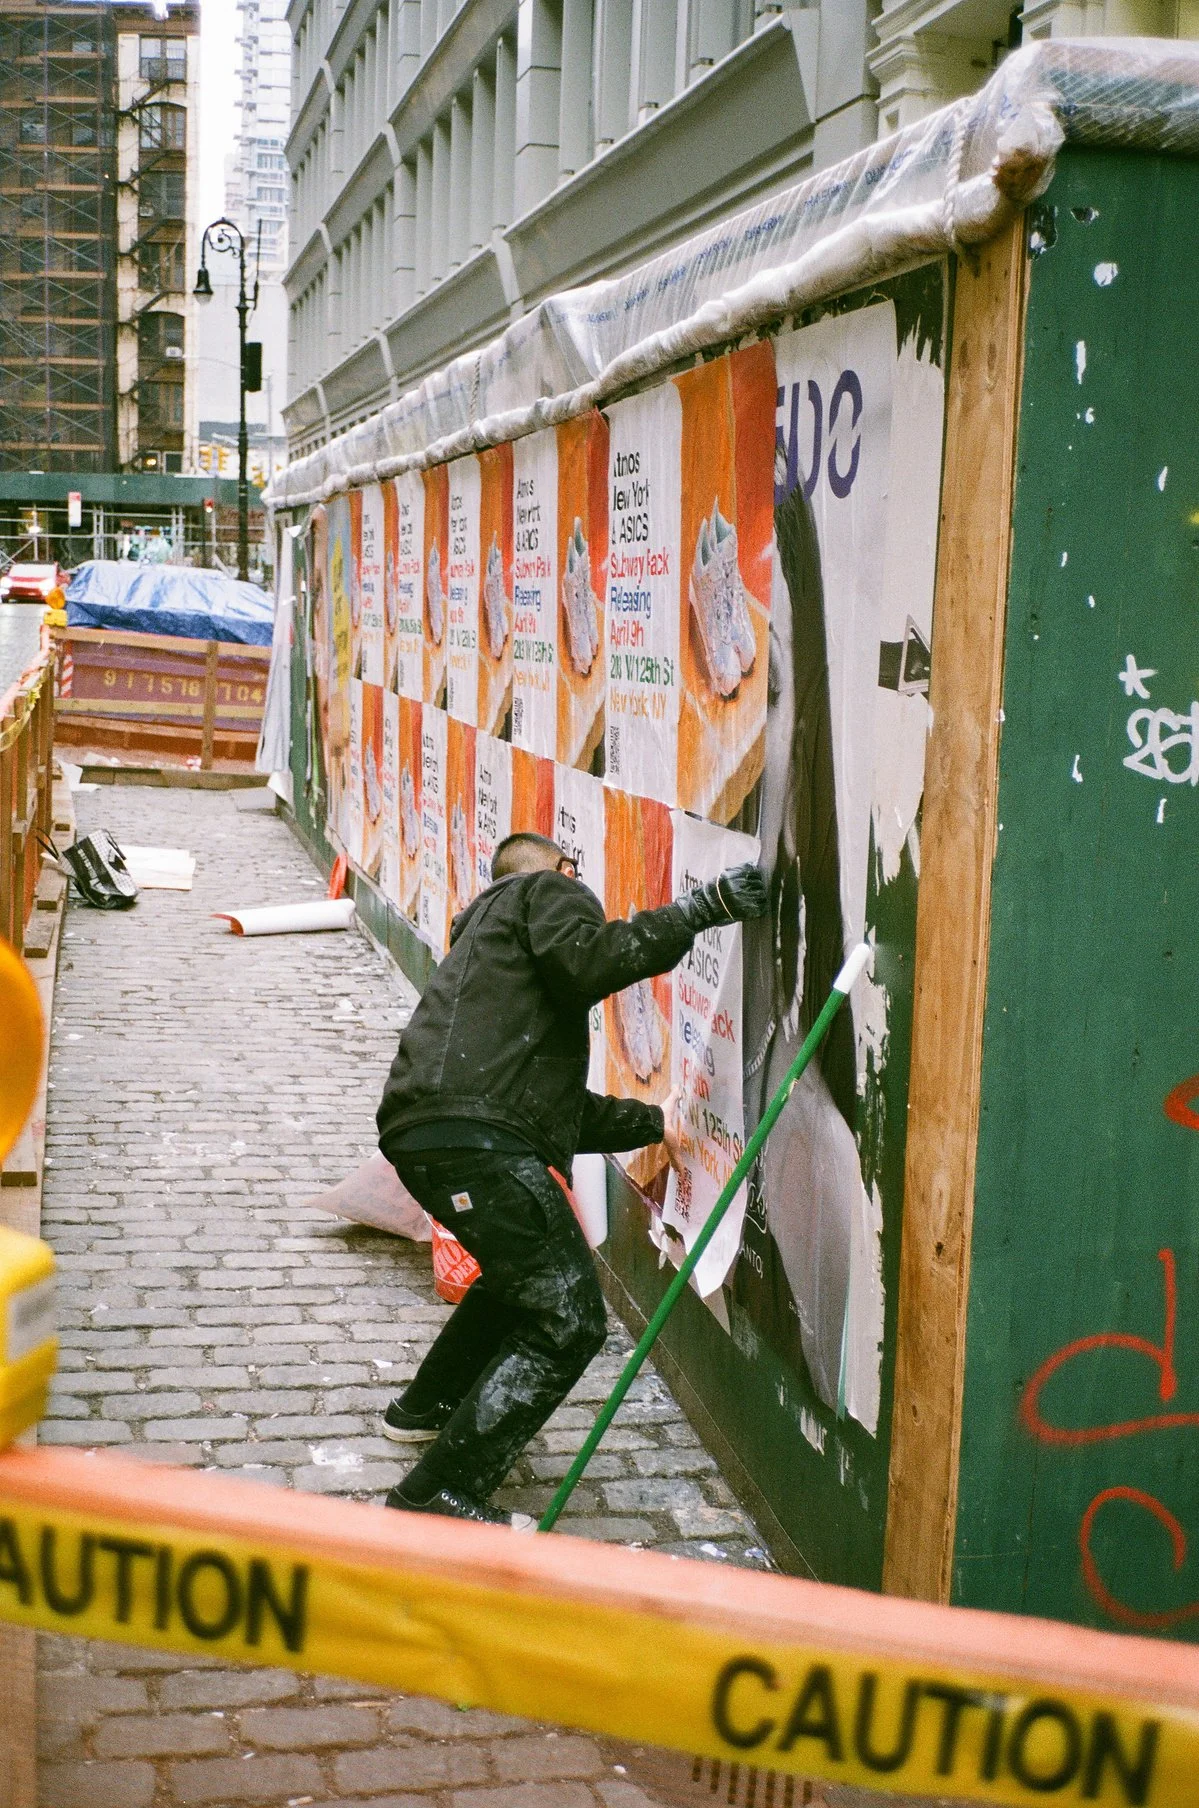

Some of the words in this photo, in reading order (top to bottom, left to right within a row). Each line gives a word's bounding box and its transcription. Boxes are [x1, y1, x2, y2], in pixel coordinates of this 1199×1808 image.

[620, 513, 649, 544] ASICS
[610, 585, 651, 619] Releasing
[663, 656, 674, 687] St
[680, 869, 703, 893] Atm
[687, 947, 719, 989] ASICS
[678, 972, 710, 1019] Subwa
[711, 1009, 735, 1044] ack
[702, 1107, 731, 1156] 125th
[711, 1655, 1161, 1807] CAUTION
